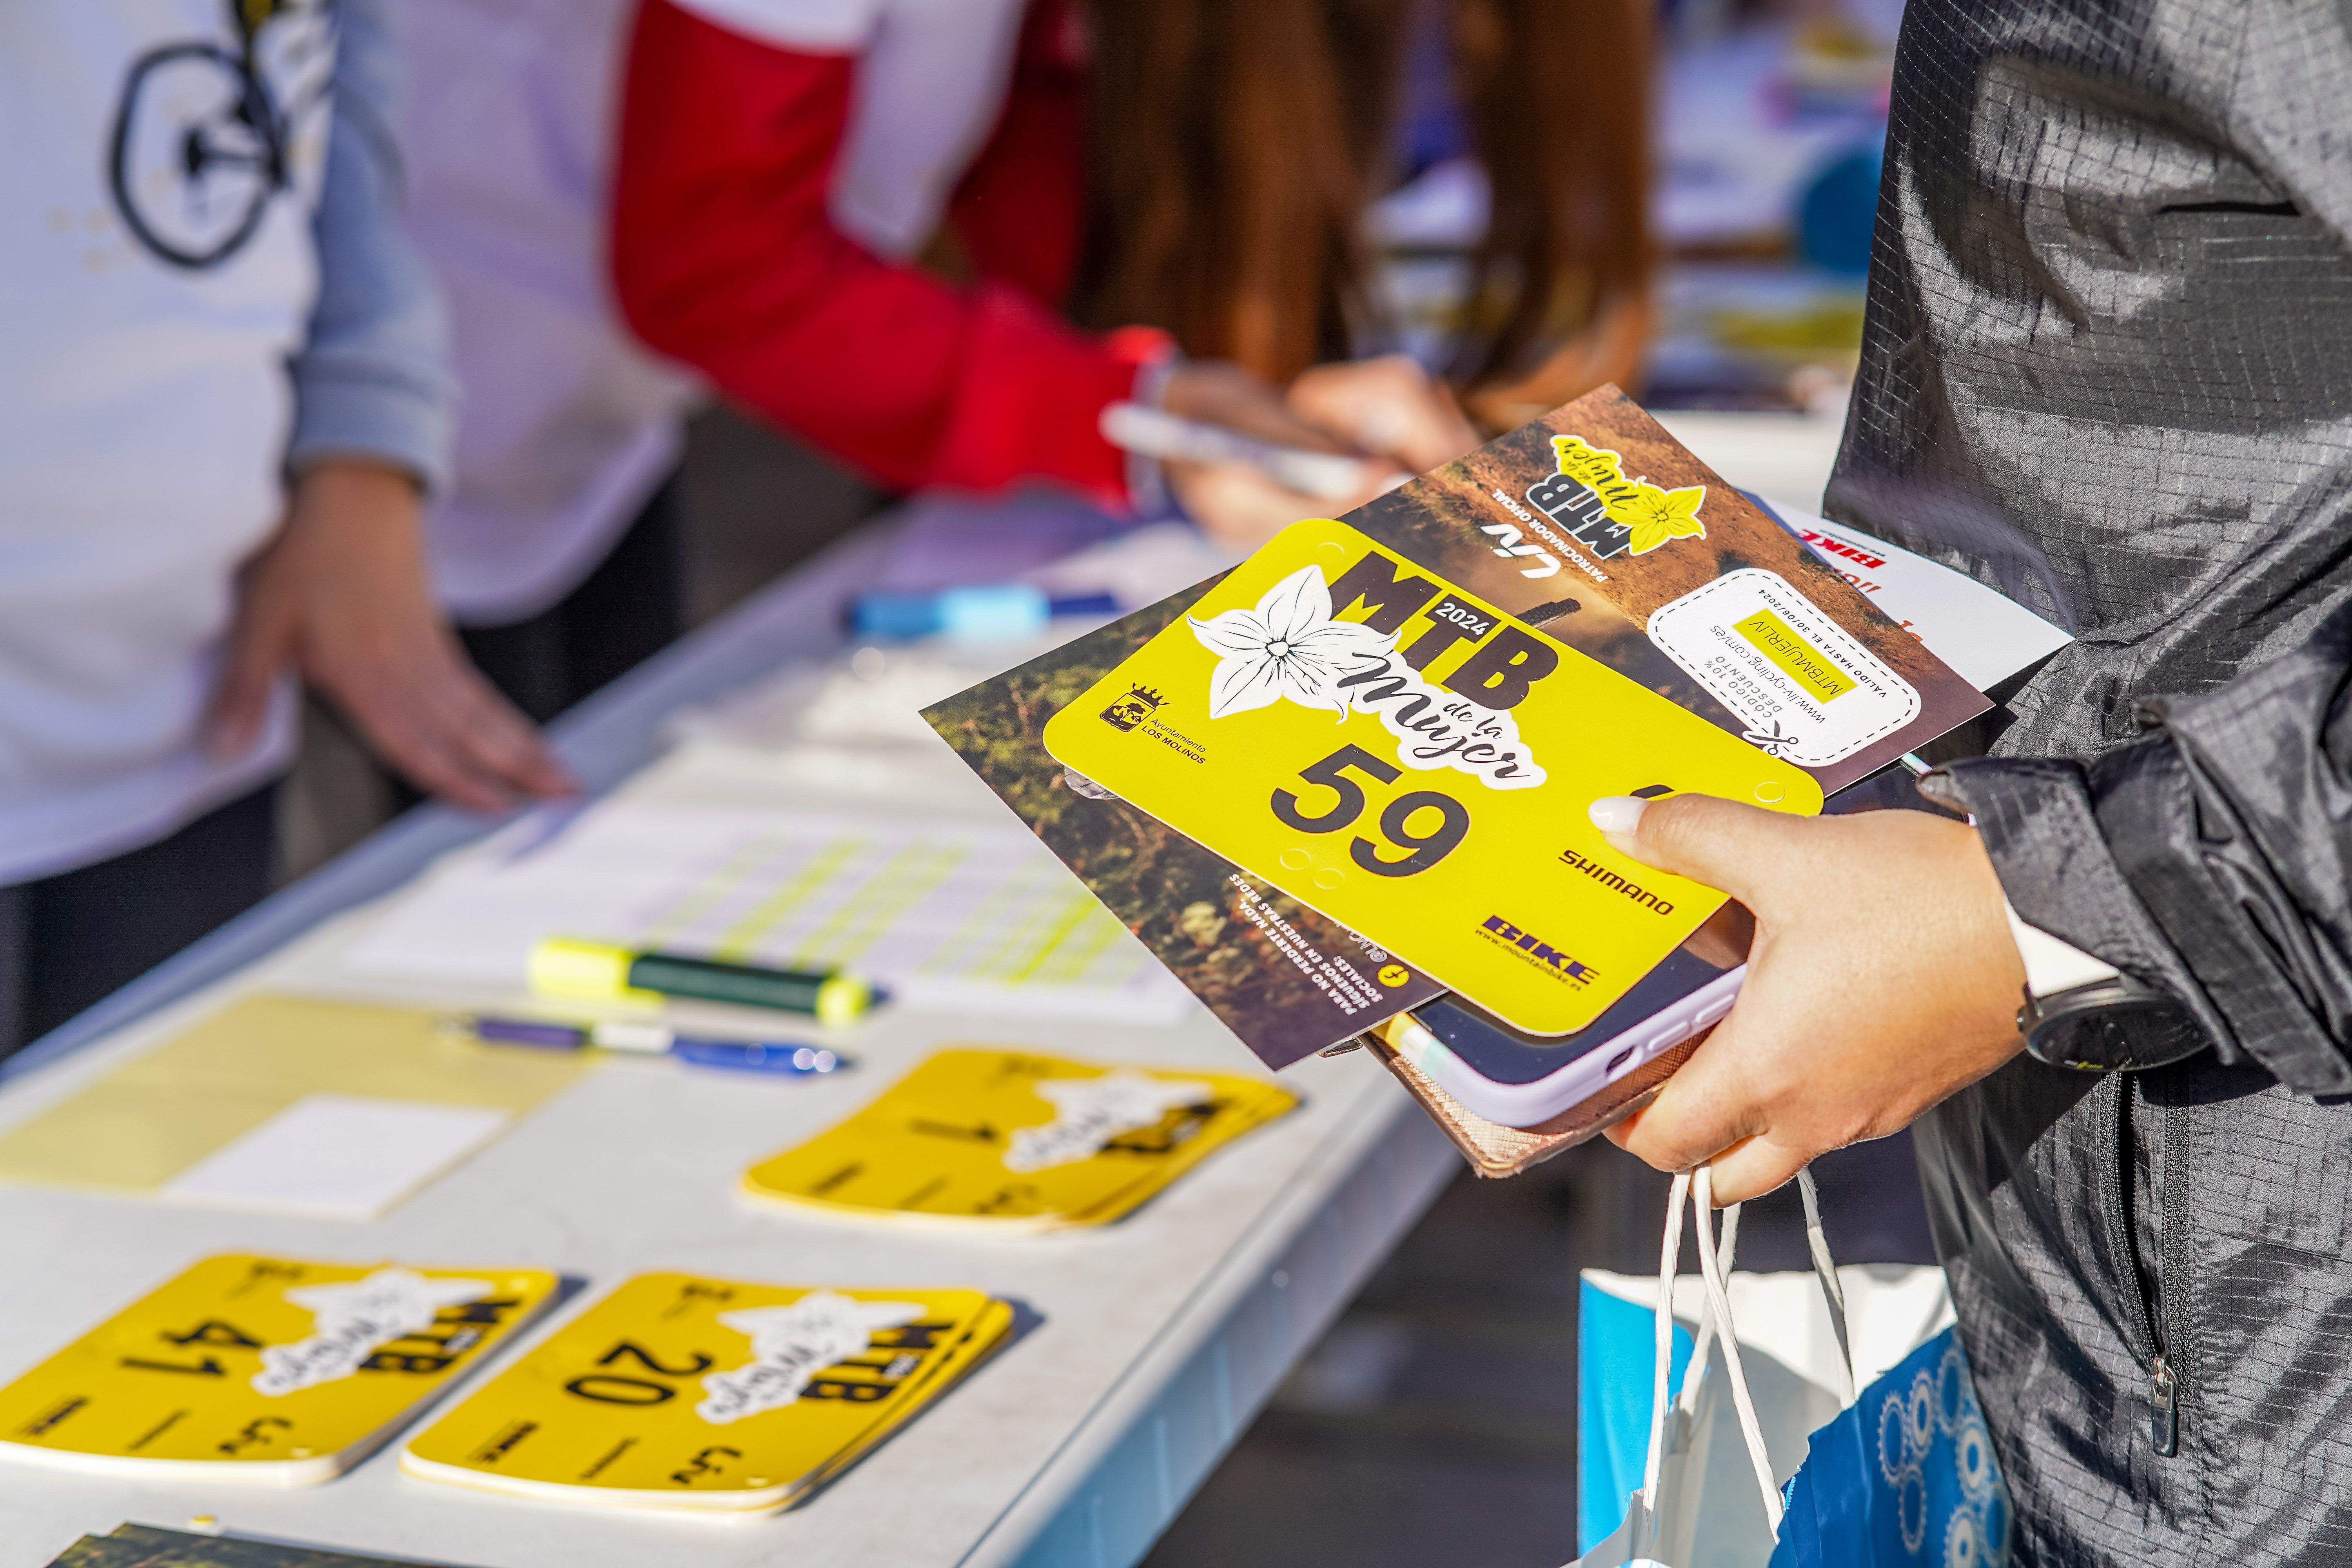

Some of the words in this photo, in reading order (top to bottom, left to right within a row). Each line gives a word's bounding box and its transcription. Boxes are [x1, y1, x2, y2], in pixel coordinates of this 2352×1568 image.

[1492, 488, 1532, 522] OFICIAL
[1528, 474, 1633, 558] MTB
[1528, 517, 1608, 583] PATROCINADOR
[1327, 550, 1559, 710] MTB
[1435, 602, 1489, 637] 2024
[1758, 590, 1810, 632] 30/06/2024
[1748, 621, 1843, 695] MTBMUJERLIV
[1811, 633, 1823, 643] EL
[1823, 644, 1854, 669] HASTA
[1704, 661, 1726, 679] 10%
[1710, 625, 1826, 724] www.liv-cycling.com/es
[1715, 656, 1782, 713] DESCUENTO
[1854, 670, 1887, 698] VÁLIDO
[1443, 702, 1474, 722] de
[1477, 715, 1504, 739] la
[1728, 682, 1772, 718] CÓDIGO
[1142, 726, 1162, 739] LOS
[1162, 737, 1206, 764] MOLINOS
[1150, 719, 1206, 752] Ayuntamiento
[1270, 743, 1470, 878] 59
[1229, 874, 1261, 903] REDES
[1559, 849, 1675, 915] SHIMANO
[1239, 898, 1269, 929] NADA,
[1258, 902, 1308, 949] NUESTRAS
[1265, 928, 1315, 974] PERDERTE
[1305, 948, 1323, 963] EN
[1481, 915, 1600, 984] BIKE
[1312, 974, 1331, 990] NO
[1333, 955, 1383, 1002] SOCIALES:
[1328, 988, 1357, 1015] PARA
[120, 1318, 265, 1378] 41
[799, 1324, 956, 1402] MTB
[564, 1341, 714, 1406] 20
